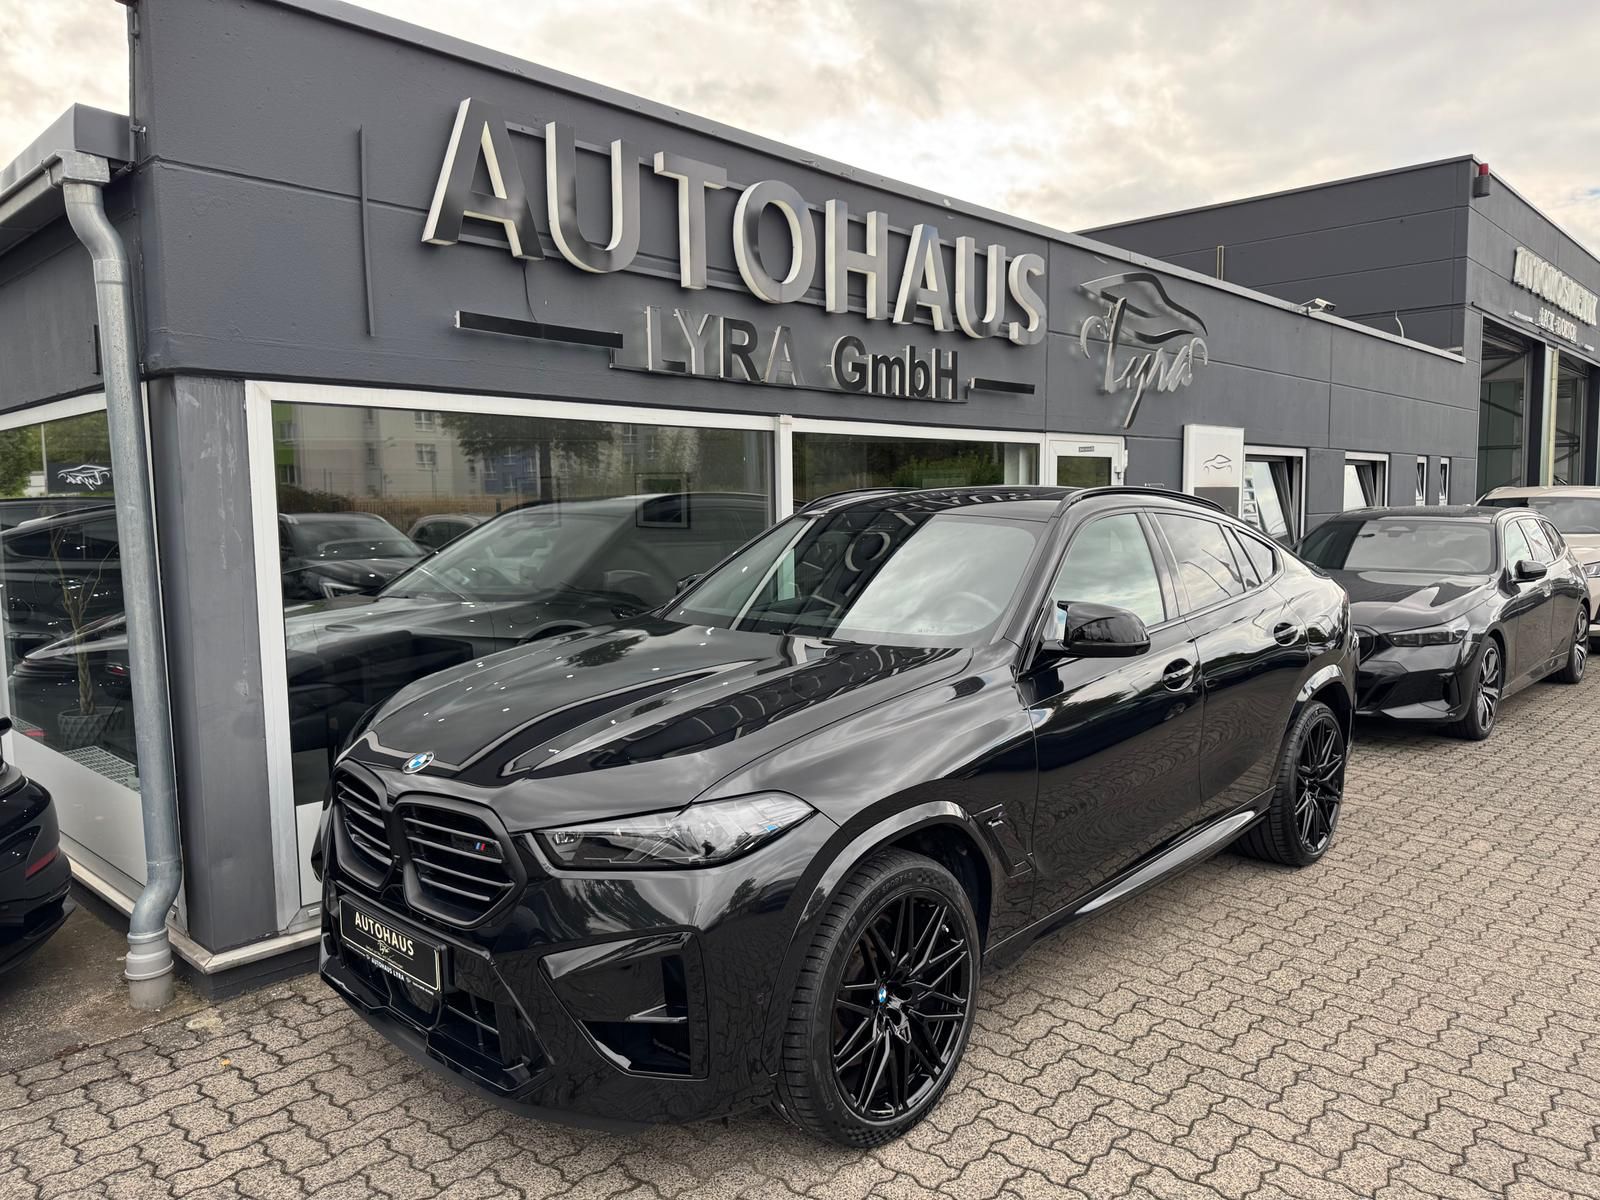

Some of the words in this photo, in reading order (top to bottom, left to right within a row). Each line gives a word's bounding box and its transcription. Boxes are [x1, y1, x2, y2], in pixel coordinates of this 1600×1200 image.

[421, 97, 1046, 346] AUTOHAUS
[645, 304, 798, 386] LYRA
[834, 335, 959, 400] GmbH
[355, 911, 414, 956] AUTOHAUS
